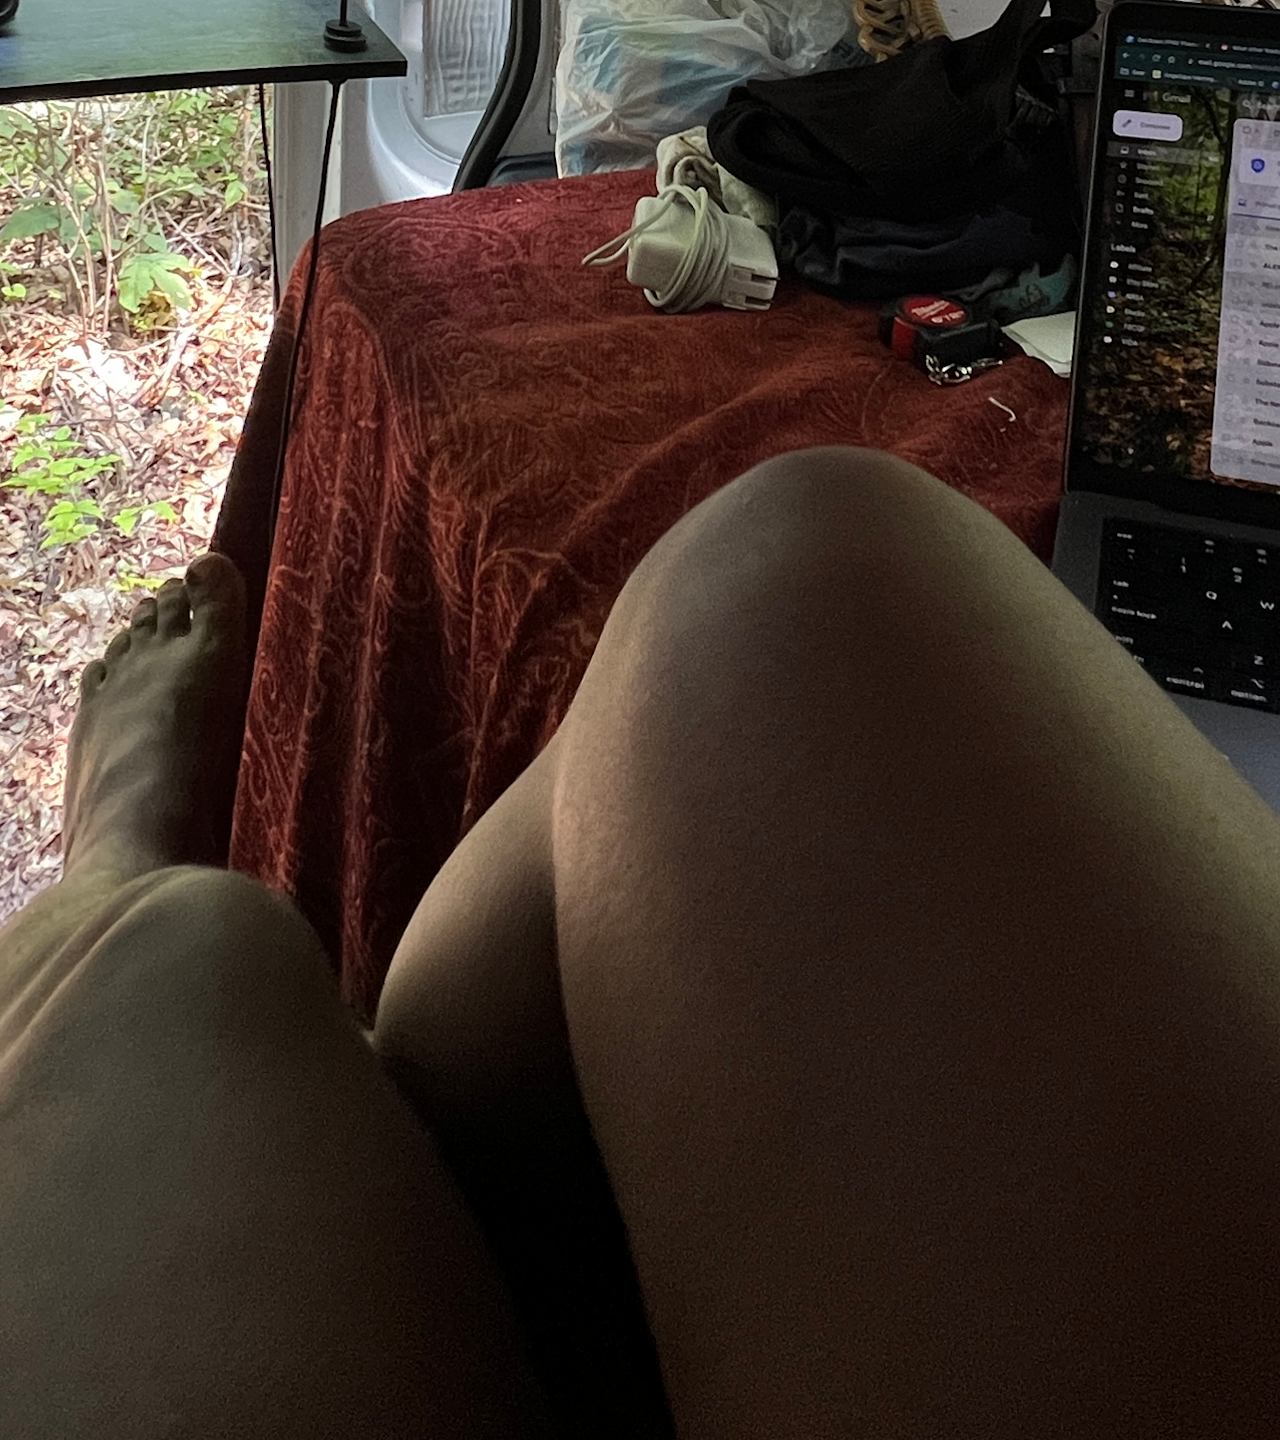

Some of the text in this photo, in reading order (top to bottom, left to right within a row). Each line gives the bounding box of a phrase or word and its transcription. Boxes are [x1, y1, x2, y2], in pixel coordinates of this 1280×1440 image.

[1162, 92, 1191, 104] Gmail
[1110, 243, 1136, 253] Labels
[1266, 243, 1278, 251] The
[1255, 398, 1268, 406] The
[1234, 574, 1242, 583] 2
[1206, 591, 1217, 600] Q
[1260, 600, 1275, 610] W
[1222, 621, 1232, 630] A
[1254, 655, 1264, 665] Z
[1167, 677, 1205, 689] control
[1231, 690, 1268, 702] option
